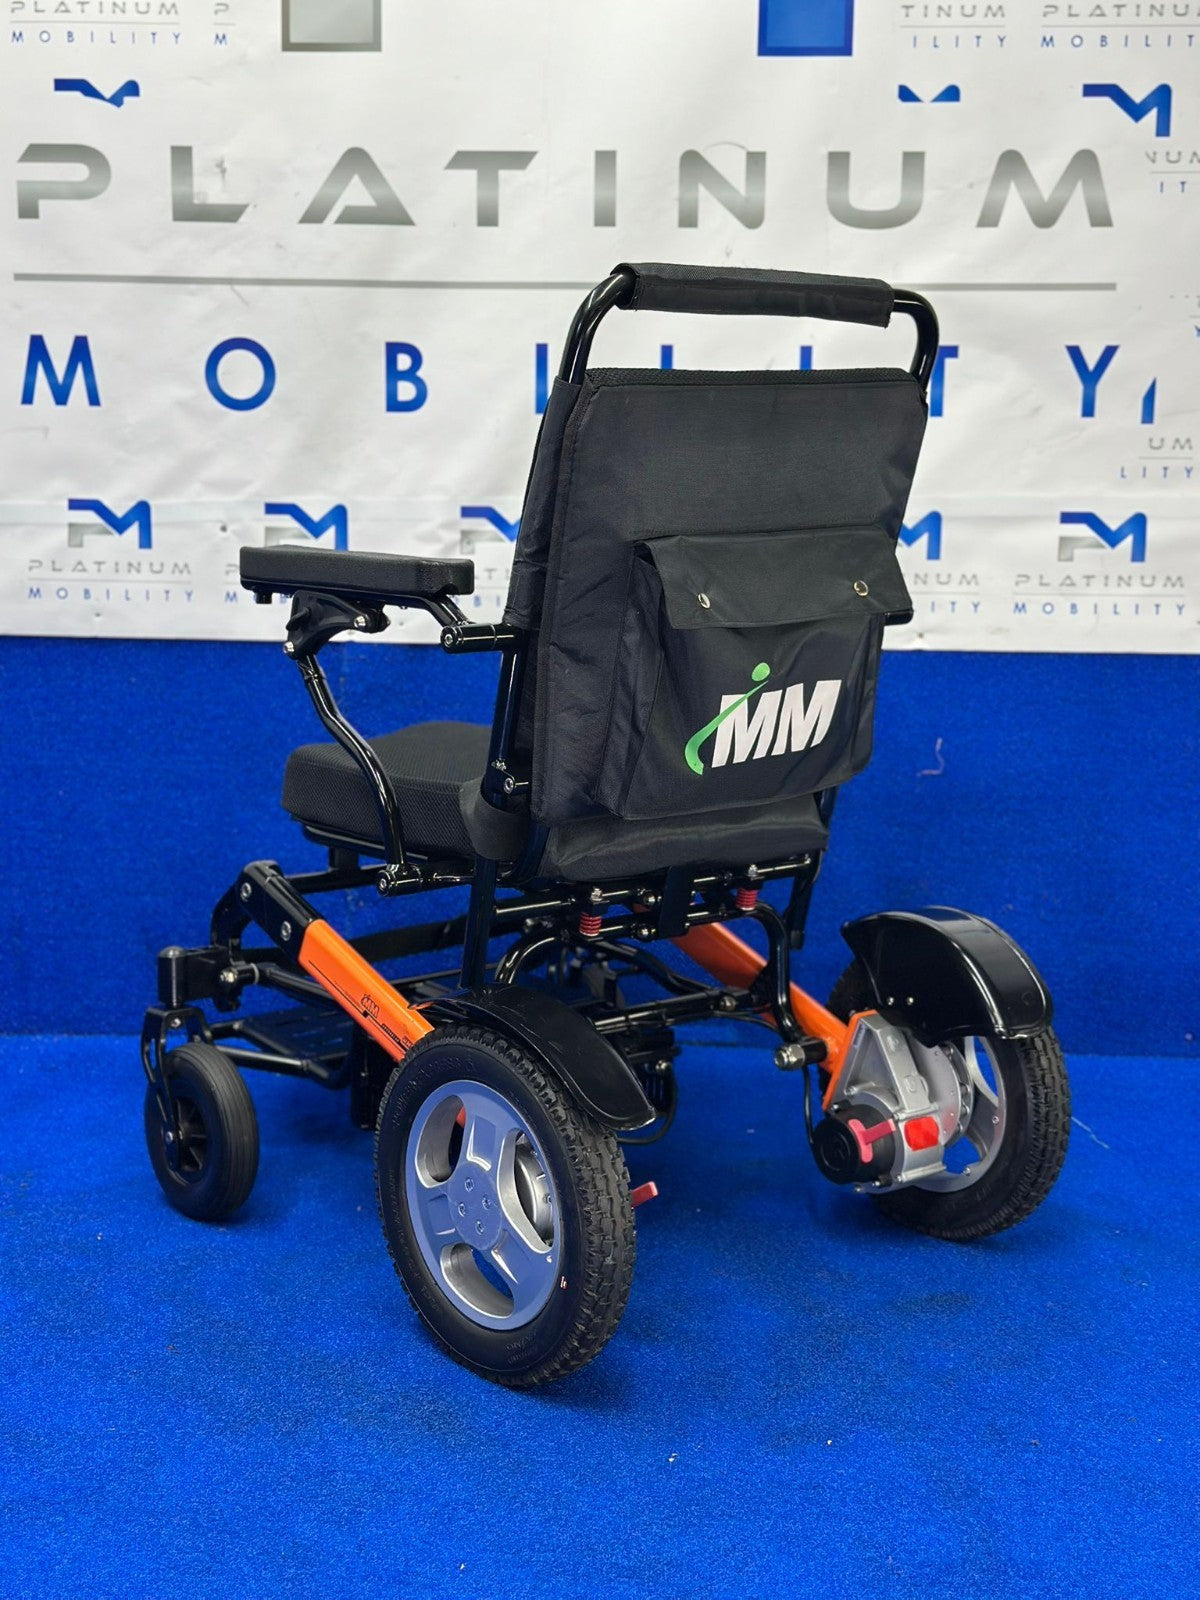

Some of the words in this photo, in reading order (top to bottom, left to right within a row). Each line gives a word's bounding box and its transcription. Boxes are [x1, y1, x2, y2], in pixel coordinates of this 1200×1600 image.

[1042, 4, 1200, 18] PLATINU
[11, 30, 181, 44] MOBILITY
[16, 142, 1113, 230] PLATINUM
[28, 560, 192, 575] PLATINUM
[1014, 573, 1186, 588] PLATINUM
[28, 586, 194, 603] MOBILITY
[1013, 601, 1186, 616] MOBILITY
